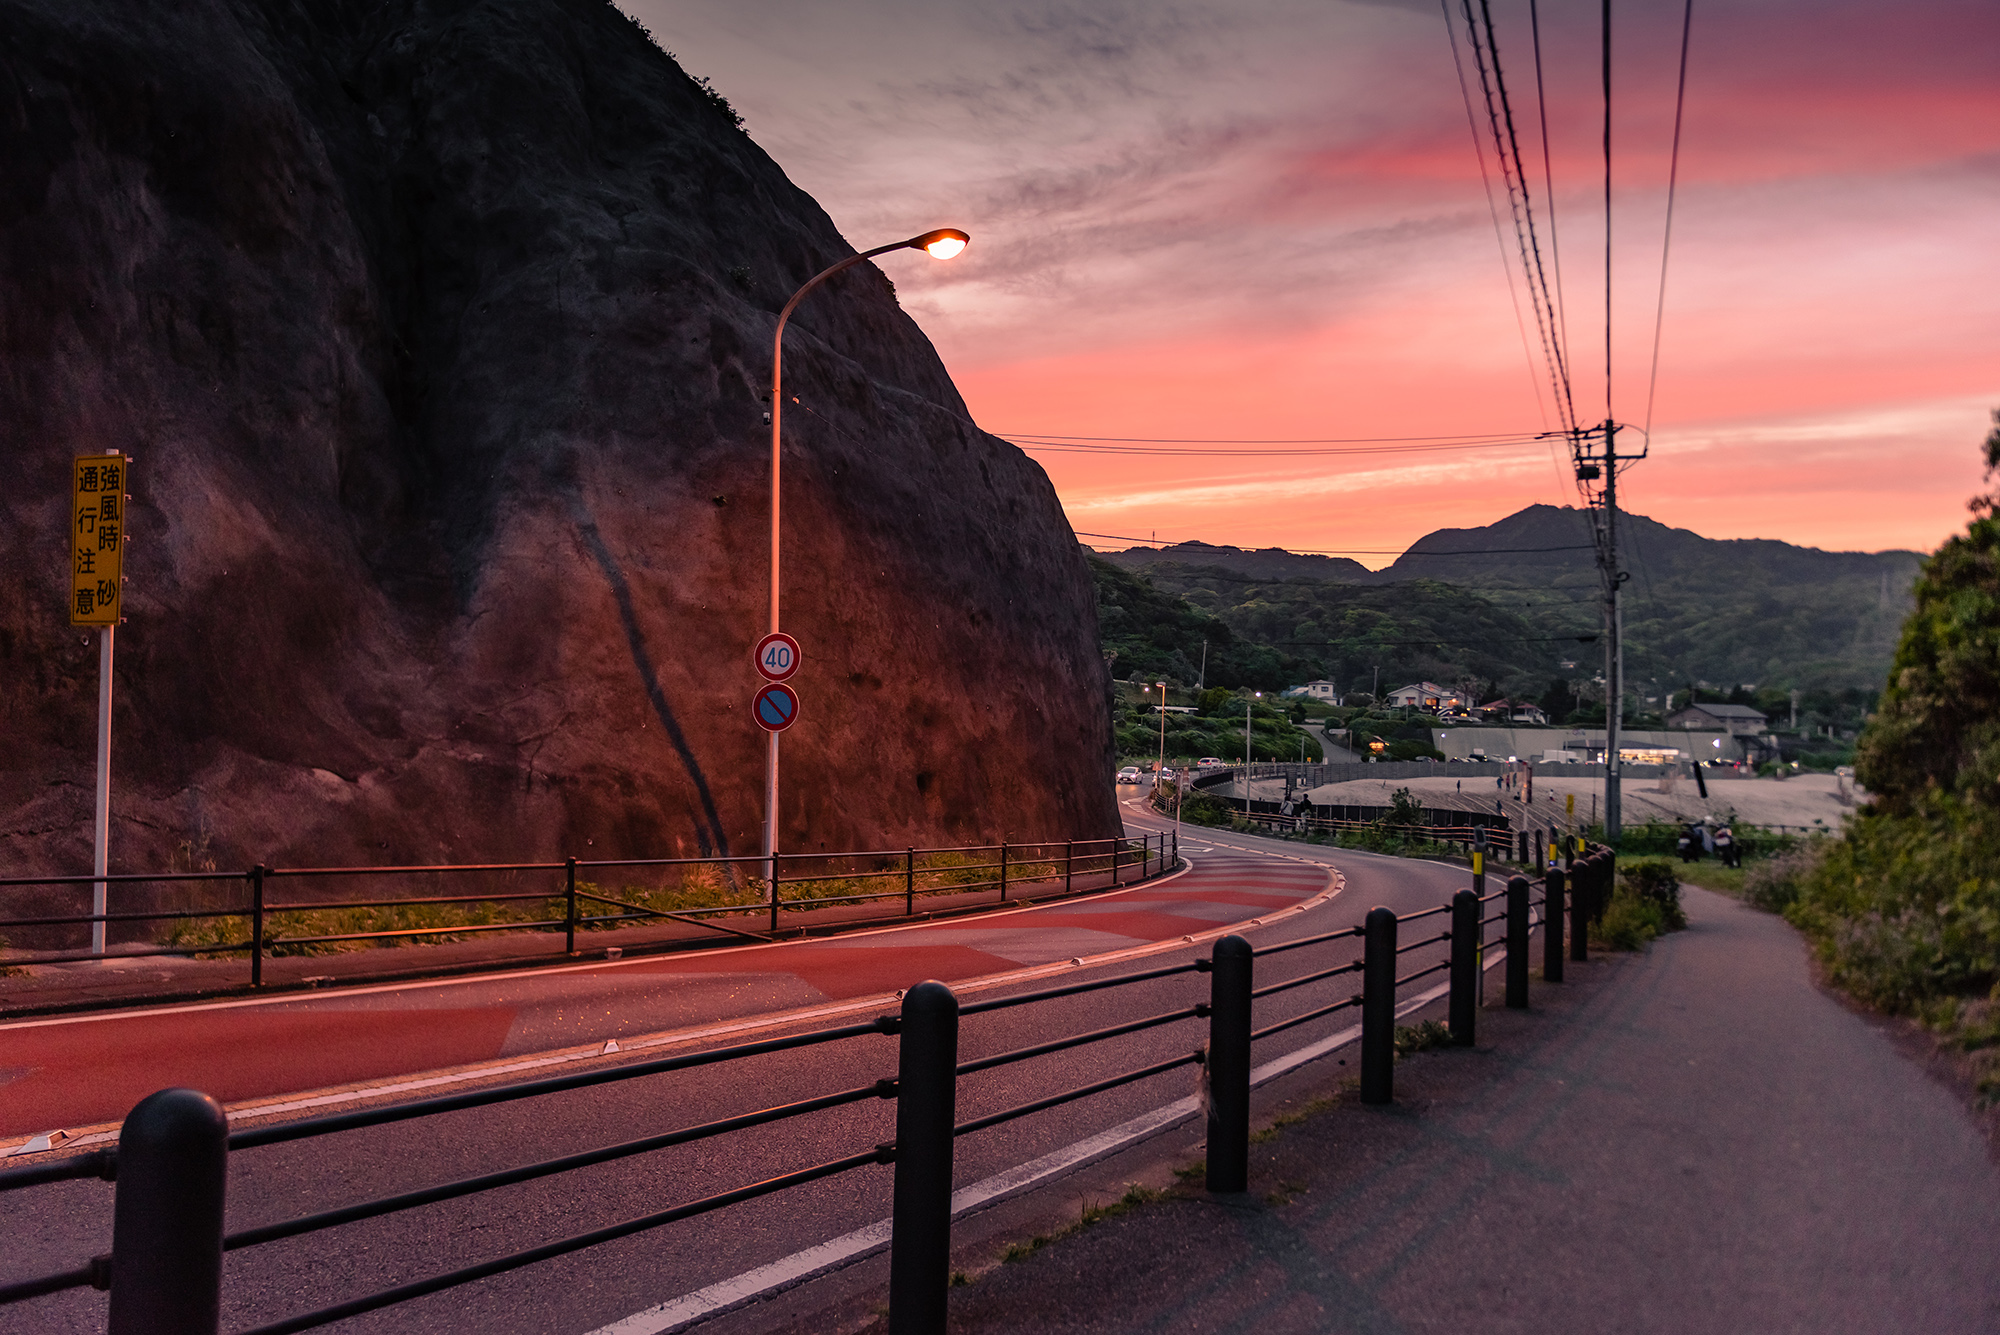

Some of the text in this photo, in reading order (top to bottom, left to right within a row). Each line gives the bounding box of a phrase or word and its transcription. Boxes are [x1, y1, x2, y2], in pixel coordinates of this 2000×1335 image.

[76, 466, 98, 615] 通行注意
[765, 647, 790, 668] 40
